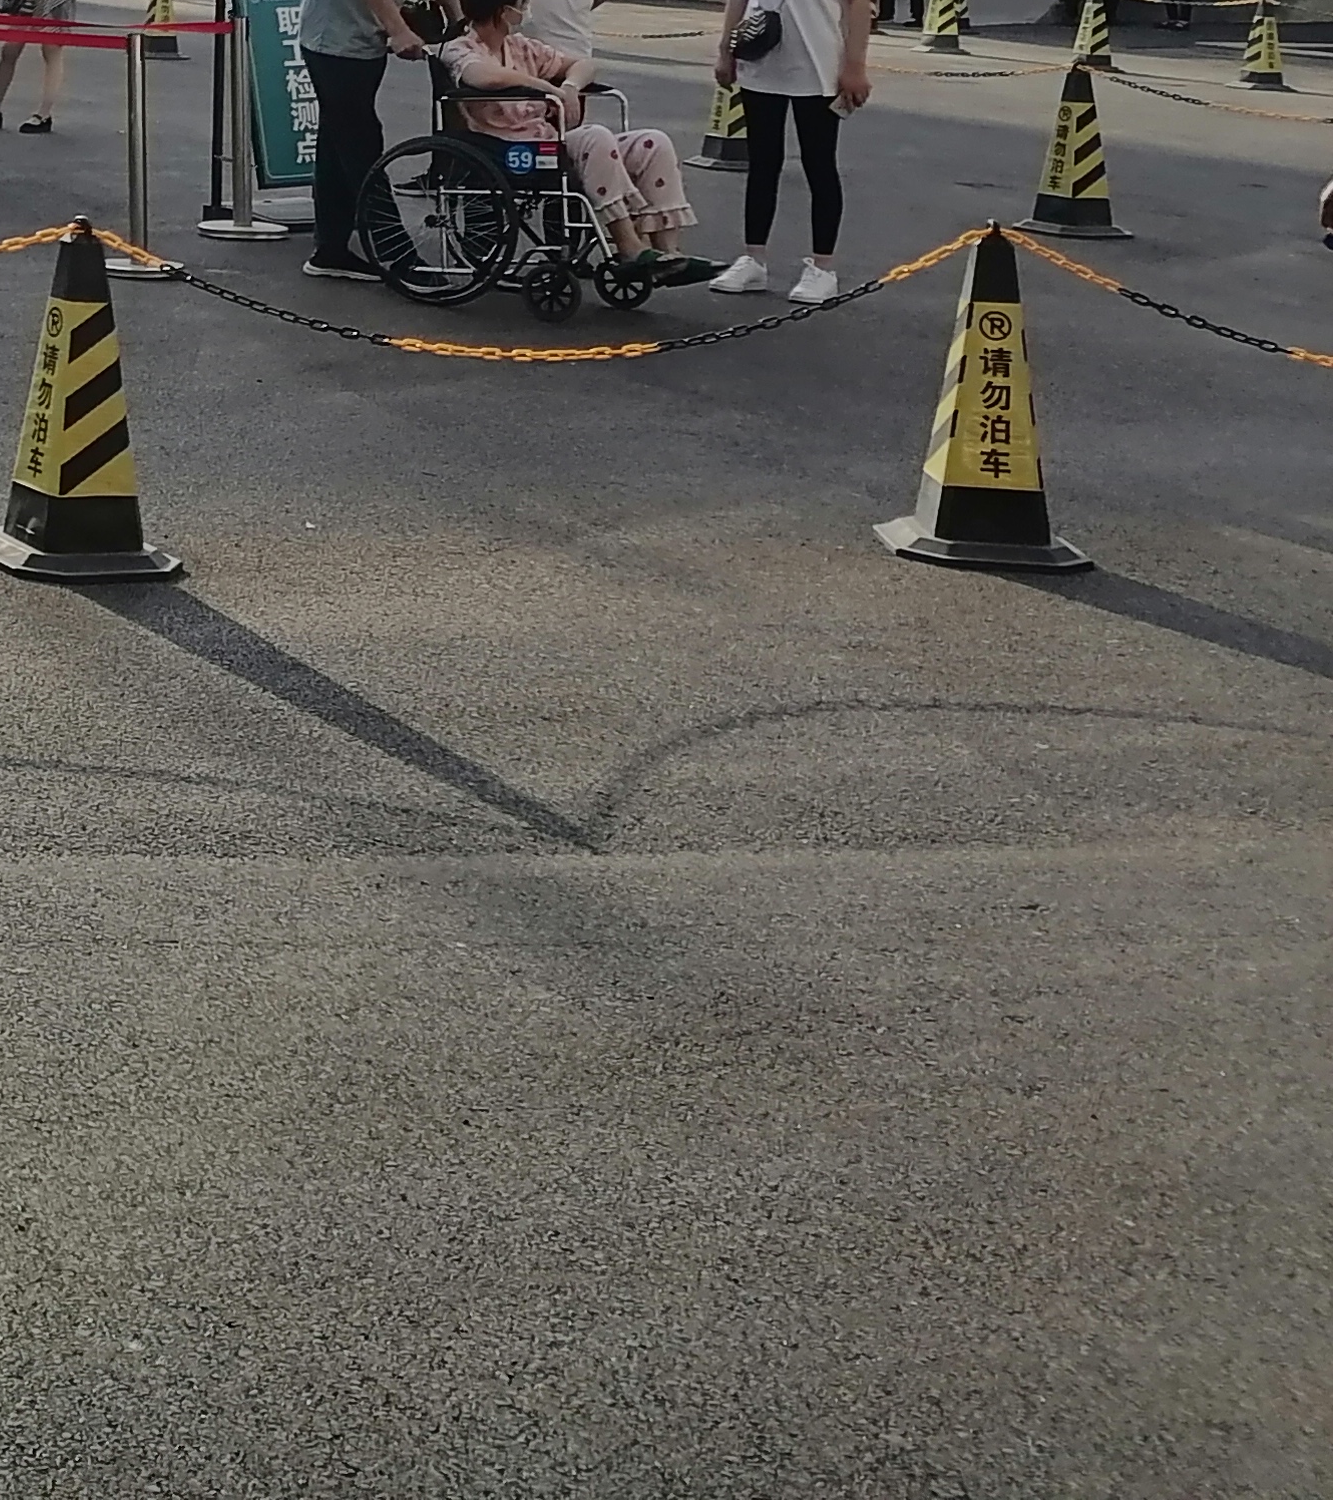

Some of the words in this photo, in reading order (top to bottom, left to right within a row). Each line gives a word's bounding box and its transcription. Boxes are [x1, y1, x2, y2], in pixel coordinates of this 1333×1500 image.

[507, 151, 533, 169] 59
[1048, 124, 1070, 191] 请勿泊车
[27, 343, 60, 478] 请勿泊车
[979, 347, 1013, 479] 请勿泊车
